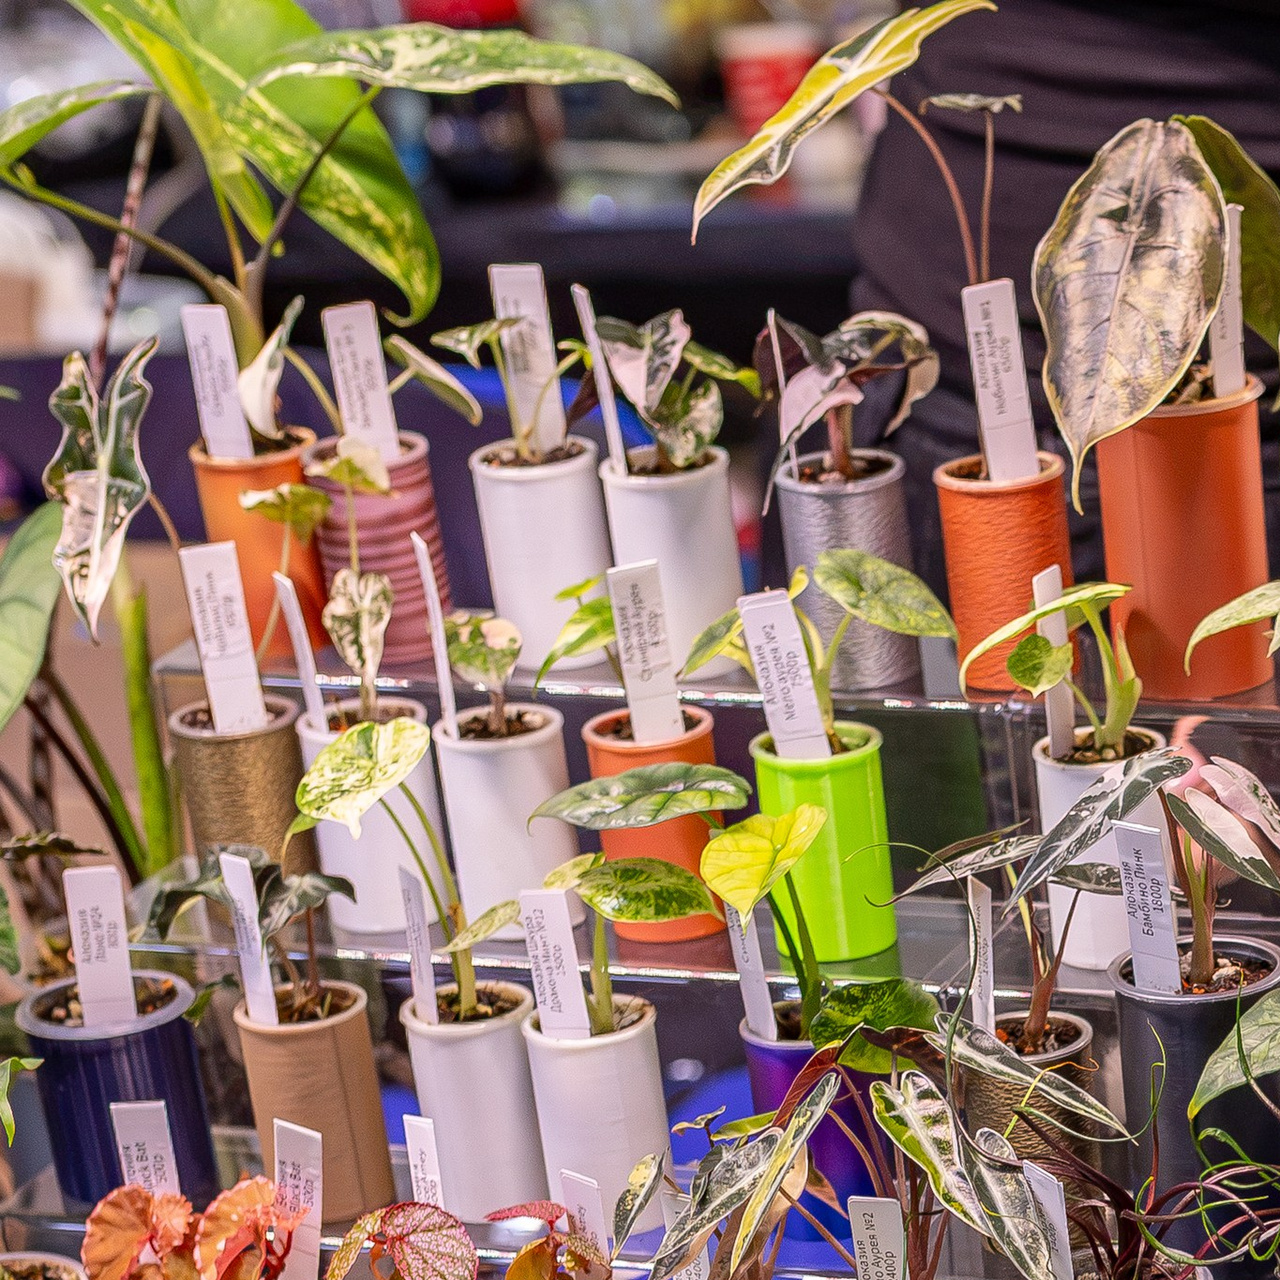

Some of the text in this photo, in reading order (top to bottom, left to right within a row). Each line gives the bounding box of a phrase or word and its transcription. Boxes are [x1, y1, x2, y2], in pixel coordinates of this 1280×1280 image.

[761, 622, 778, 644] №2
[755, 644, 777, 705] Алоказия
[781, 685, 798, 721] Мело
[1123, 861, 1137, 919] Алоказия
[1133, 847, 1154, 936] Бамбино Пинк
[1149, 877, 1164, 913] 1800р
[289, 1160, 301, 1212] Black Bat
[862, 1211, 876, 1231] №2
[869, 1233, 883, 1269] Аурея
